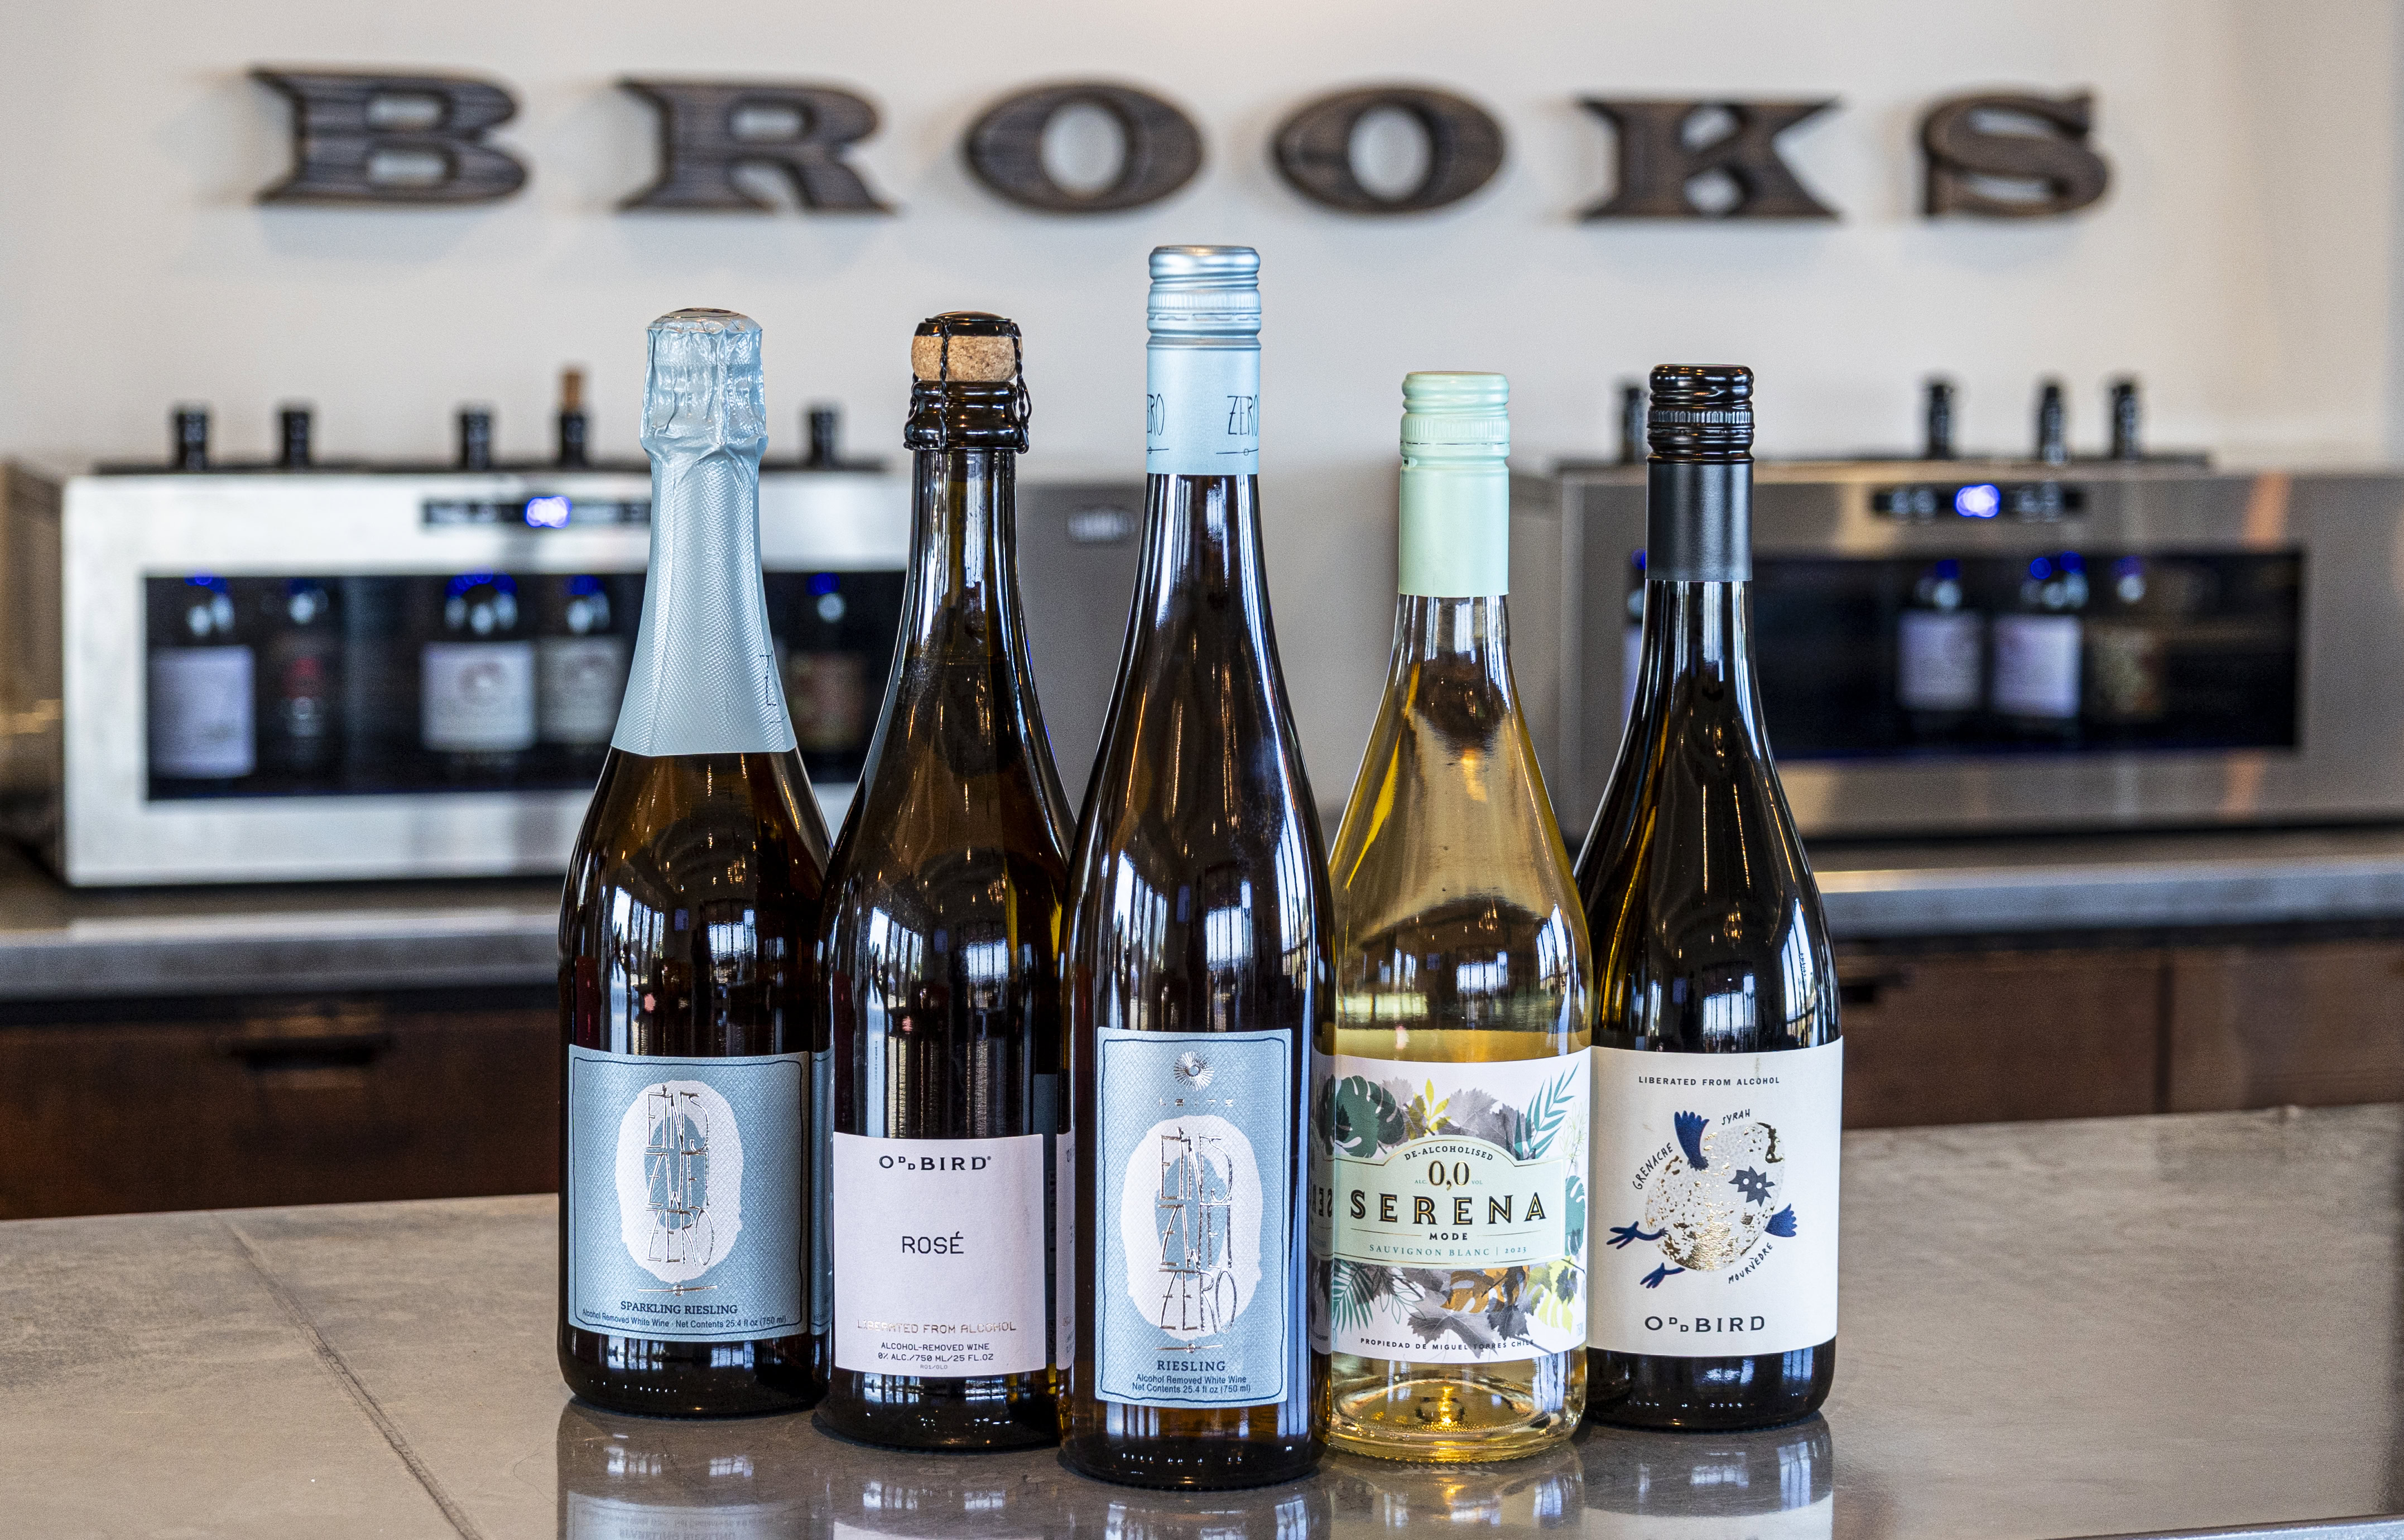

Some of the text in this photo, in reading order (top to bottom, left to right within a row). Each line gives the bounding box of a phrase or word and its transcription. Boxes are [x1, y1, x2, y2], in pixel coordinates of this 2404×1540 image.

[249, 64, 2116, 221] BROOKS
[1227, 394, 1259, 437] ZERO
[1638, 1076, 1696, 1086] LIBERATED
[1737, 1077, 1780, 1085] ALCOHOL
[1722, 1109, 1751, 1125] SYRAH
[1404, 1146, 1493, 1161] DE-ALCOHOLISED
[1632, 1142, 1674, 1190] GRENACHE
[1428, 1160, 1470, 1191] 0,0
[1350, 1189, 1547, 1225] SERENA
[645, 1206, 714, 1265] ZERO
[902, 1231, 964, 1254] ROSÉ
[1429, 1232, 1468, 1240] MODE
[1369, 1244, 1441, 1256] SAUVIGNON
[621, 1301, 738, 1315] SPARKLING RIESLING
[1158, 1268, 1237, 1333] ZERO
[582, 1308, 601, 1319] Alcohol
[602, 1312, 630, 1324] Removed
[631, 1317, 650, 1326] White
[652, 1318, 669, 1327] Wine
[676, 1320, 688, 1328] Net
[690, 1320, 724, 1328] Contents
[725, 1319, 741, 1327] 25.4
[759, 1316, 775, 1327] (750
[776, 1315, 786, 1324] ml)
[858, 1320, 1016, 1334] LIBERATED FROM ALCOHOL
[881, 1342, 964, 1351] ALCOHOL-REMOVED
[1360, 1338, 1410, 1348] PROPIEDAD
[1511, 1339, 1534, 1348] CHILE
[1157, 1360, 1226, 1371] RIESLING
[1136, 1374, 1165, 1383] Alcohol
[1166, 1375, 1202, 1384] Removed
[1132, 1382, 1145, 1390] Net
[1147, 1384, 1181, 1393] Contents
[1220, 1385, 1238, 1394] (750
[1240, 1384, 1251, 1393] ml)
